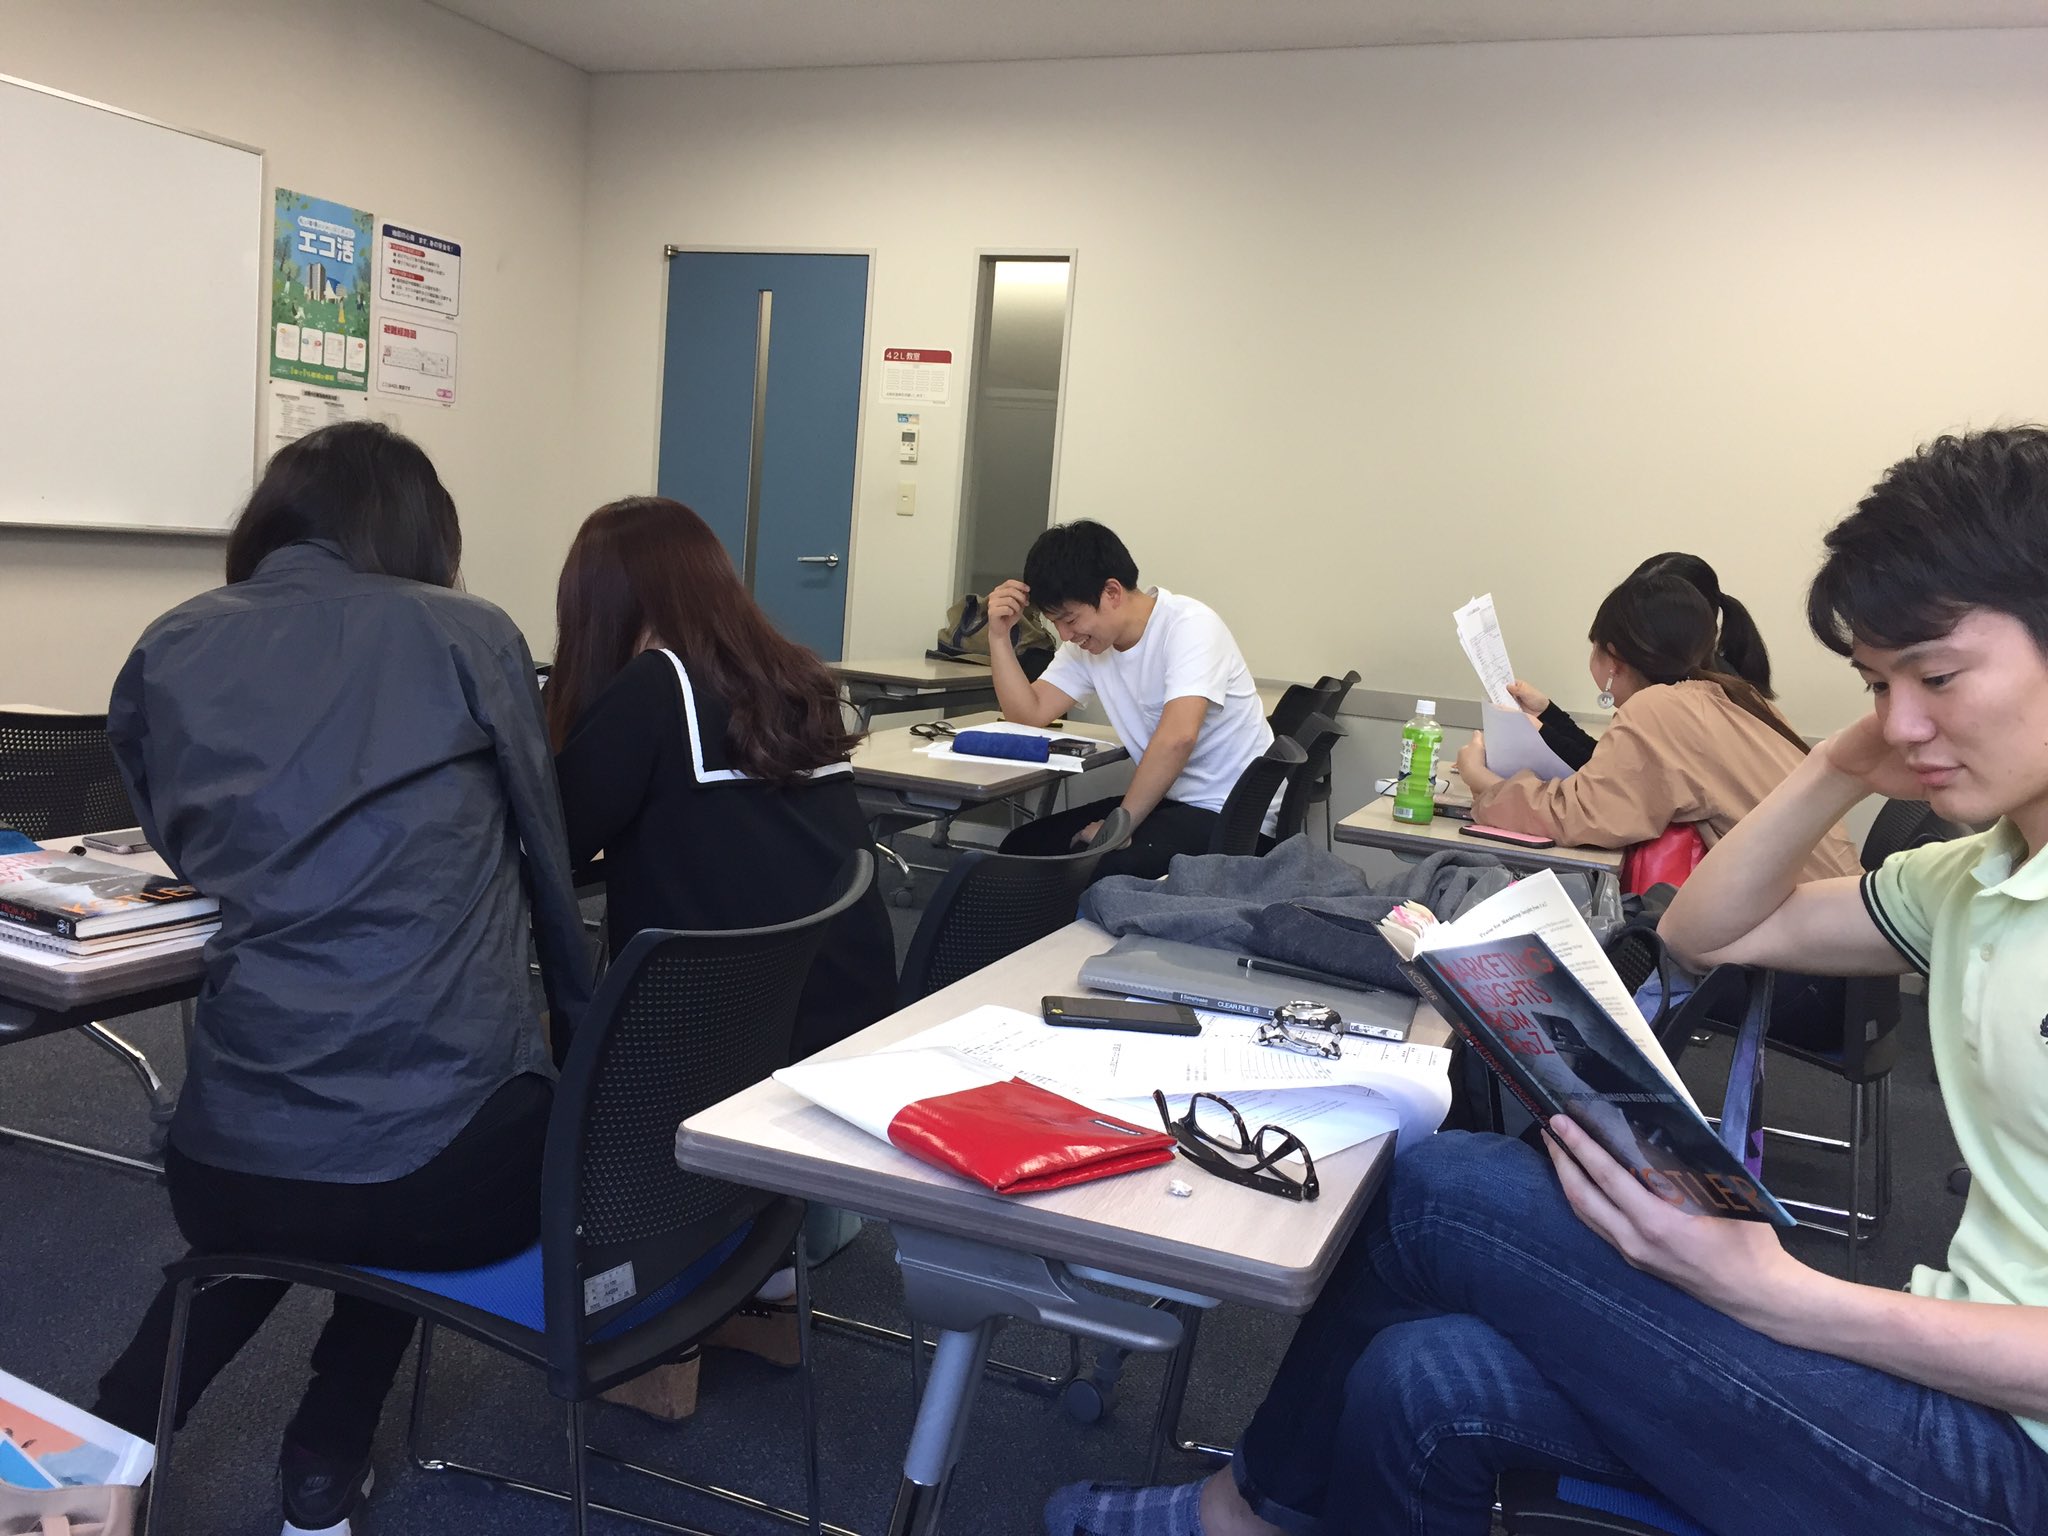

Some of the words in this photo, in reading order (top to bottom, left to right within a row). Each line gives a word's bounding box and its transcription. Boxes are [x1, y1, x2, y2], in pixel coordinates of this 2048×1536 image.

[298, 230, 354, 264] エコ活
[1437, 947, 1555, 984] MARKETING
[1407, 967, 1439, 1002] KOTLER
[1457, 978, 1552, 1009] INSIGHTS
[1217, 1001, 1238, 1010] CLEAR
[1238, 1004, 1251, 1013] FILE
[1479, 1009, 1537, 1032] FROM
[1457, 1022, 1505, 1073] MARKETING
[1528, 1031, 1556, 1055] Z
